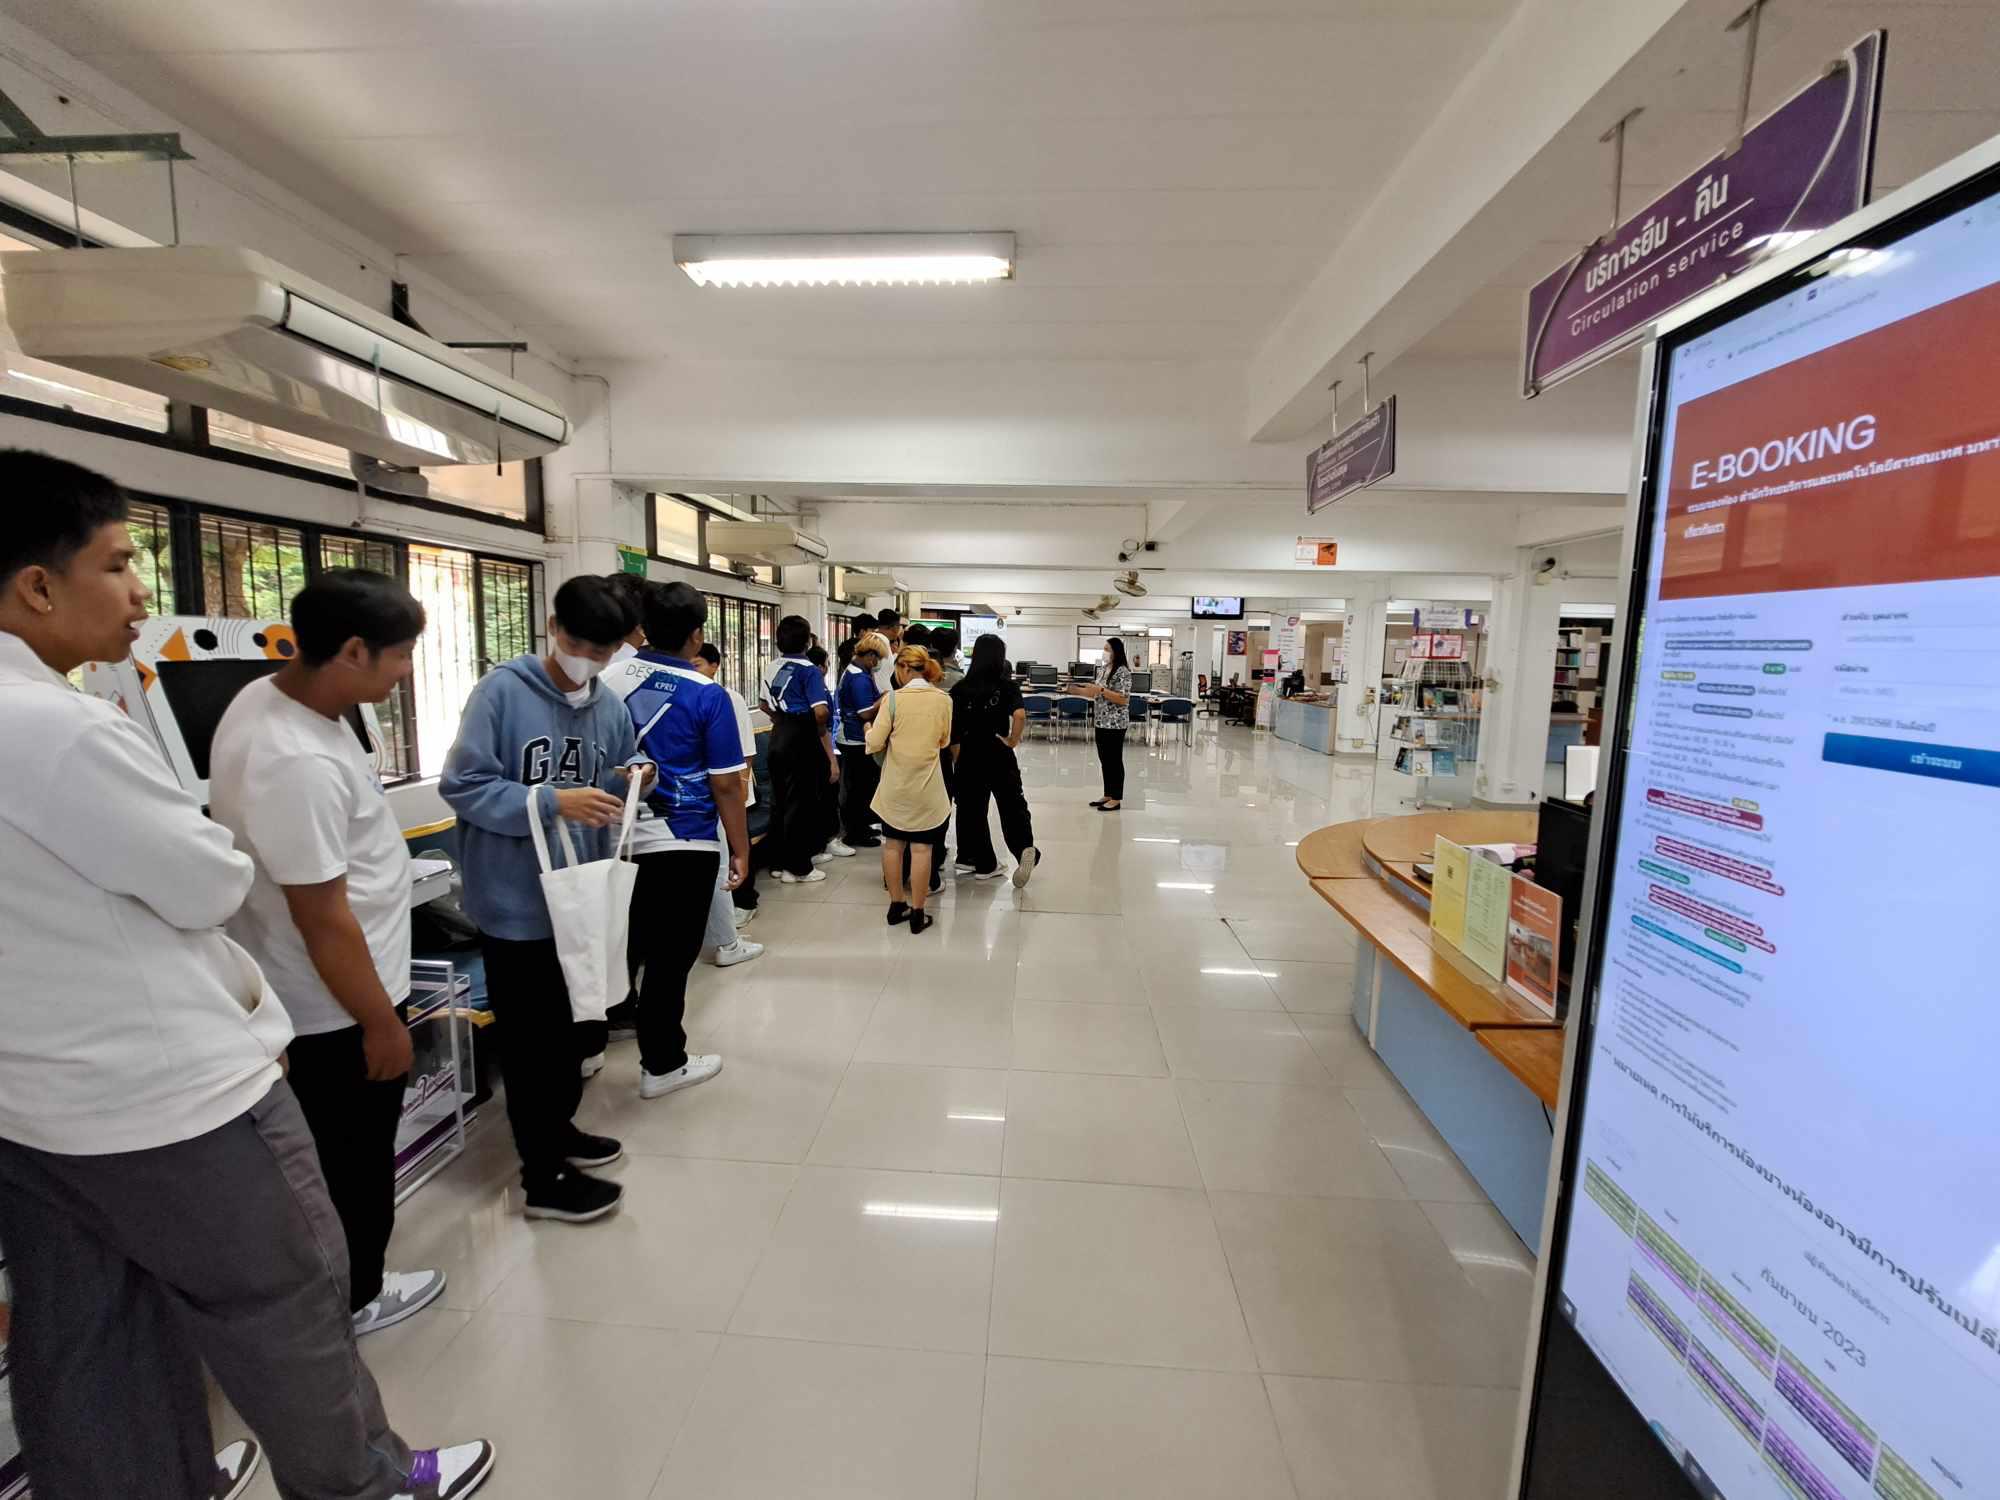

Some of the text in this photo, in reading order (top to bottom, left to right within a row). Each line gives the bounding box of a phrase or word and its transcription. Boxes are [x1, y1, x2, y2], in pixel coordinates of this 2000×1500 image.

[1570, 220, 1744, 337] Circulation service
[1585, 215, 1669, 294] บริการยืม
[1694, 173, 1729, 222] คืน
[1690, 413, 1877, 491] E-BOOKING
[654, 681, 678, 693] KPRU
[1760, 1267, 1867, 1368] กันยายน 2023
